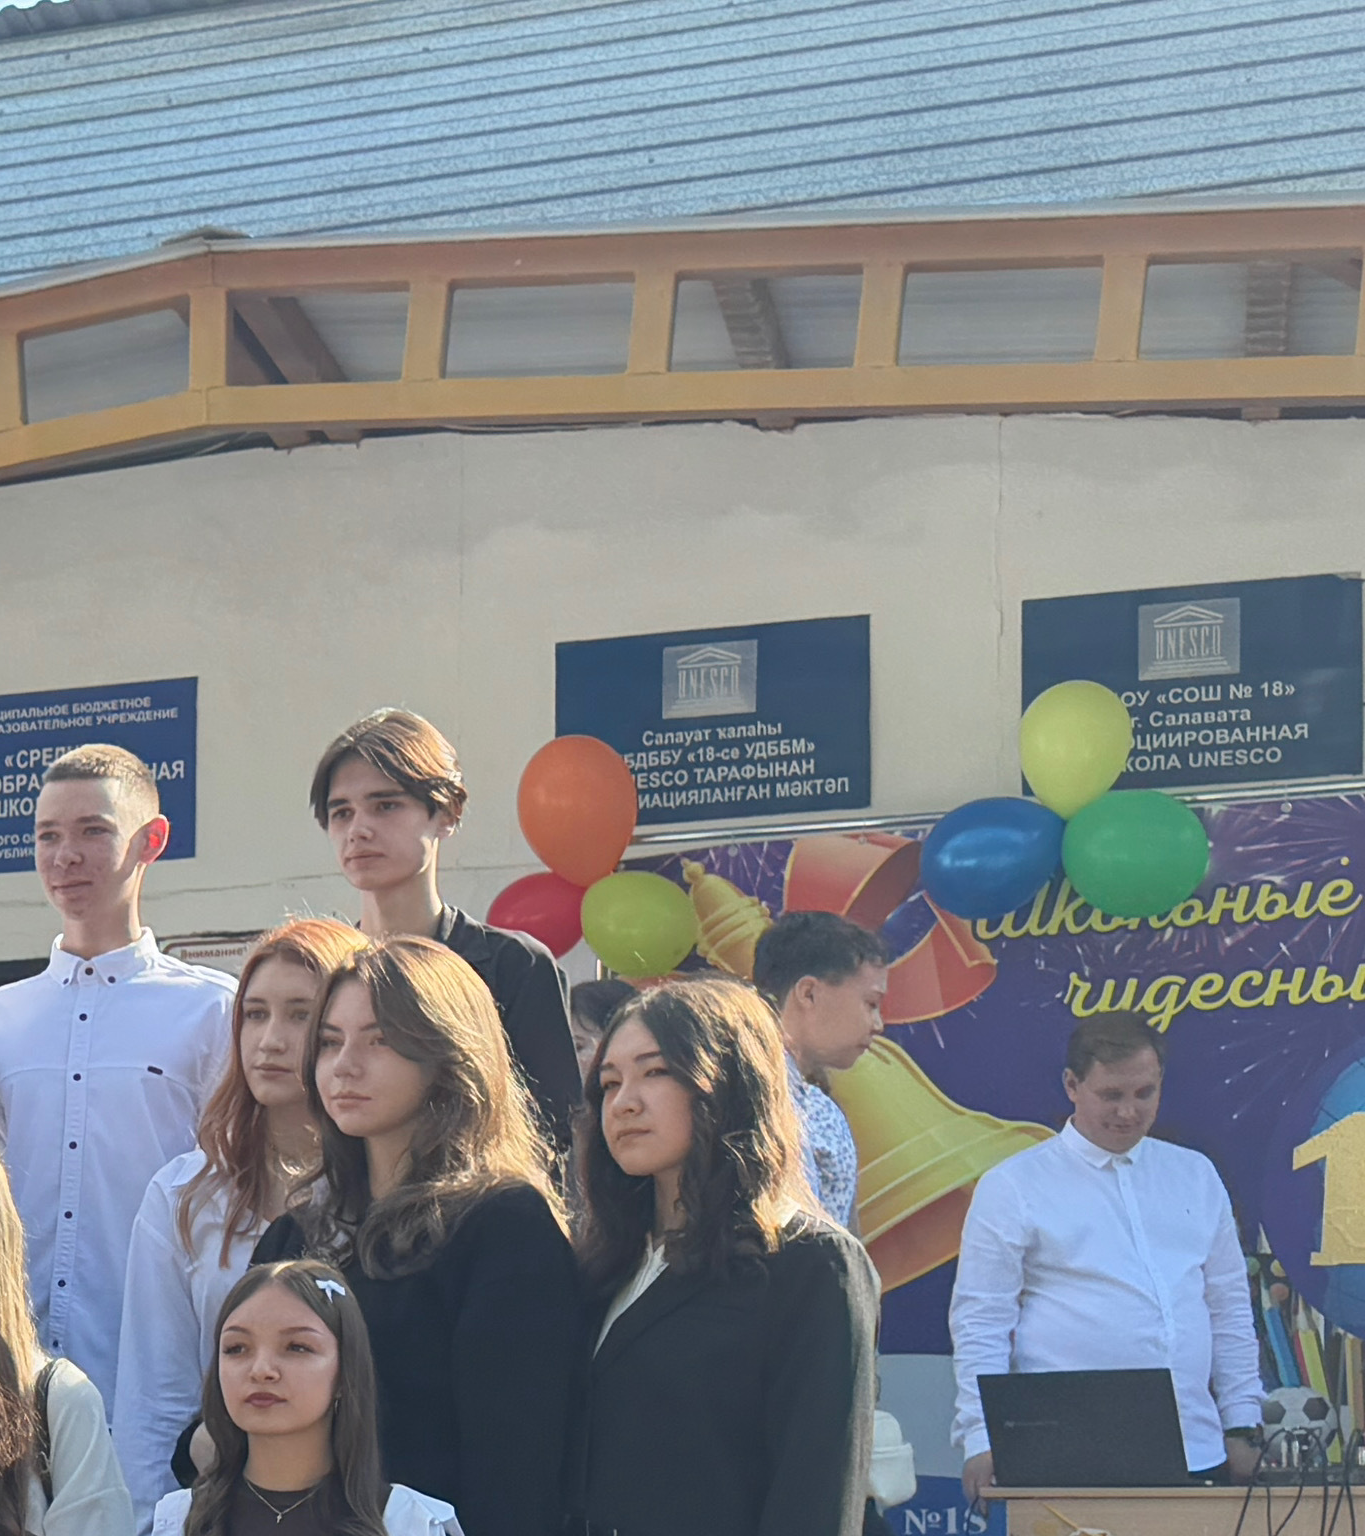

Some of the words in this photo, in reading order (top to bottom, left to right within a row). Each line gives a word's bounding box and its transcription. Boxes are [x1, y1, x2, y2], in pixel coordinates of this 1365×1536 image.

[1156, 627, 1221, 659] UNESCO
[678, 667, 739, 698] UNESCO
[1115, 690, 1150, 707] ОУ
[1156, 684, 1221, 704] «СОШ
[1259, 681, 1295, 698] 18»
[72, 696, 151, 715] БЮДЖЕТНОЕ
[96, 707, 178, 726] УЧРЕЖДЕНИЕ
[1149, 709, 1251, 727] Салавата
[642, 729, 711, 746] Салауат
[1131, 723, 1309, 752] ЦИИРОВАННАЯ
[623, 748, 682, 771] БДББУ
[1123, 753, 1182, 772] КОЛА
[1189, 747, 1282, 768] UNESCO
[632, 769, 689, 789] ESCO
[693, 759, 815, 784] ТАРАФЫНАН
